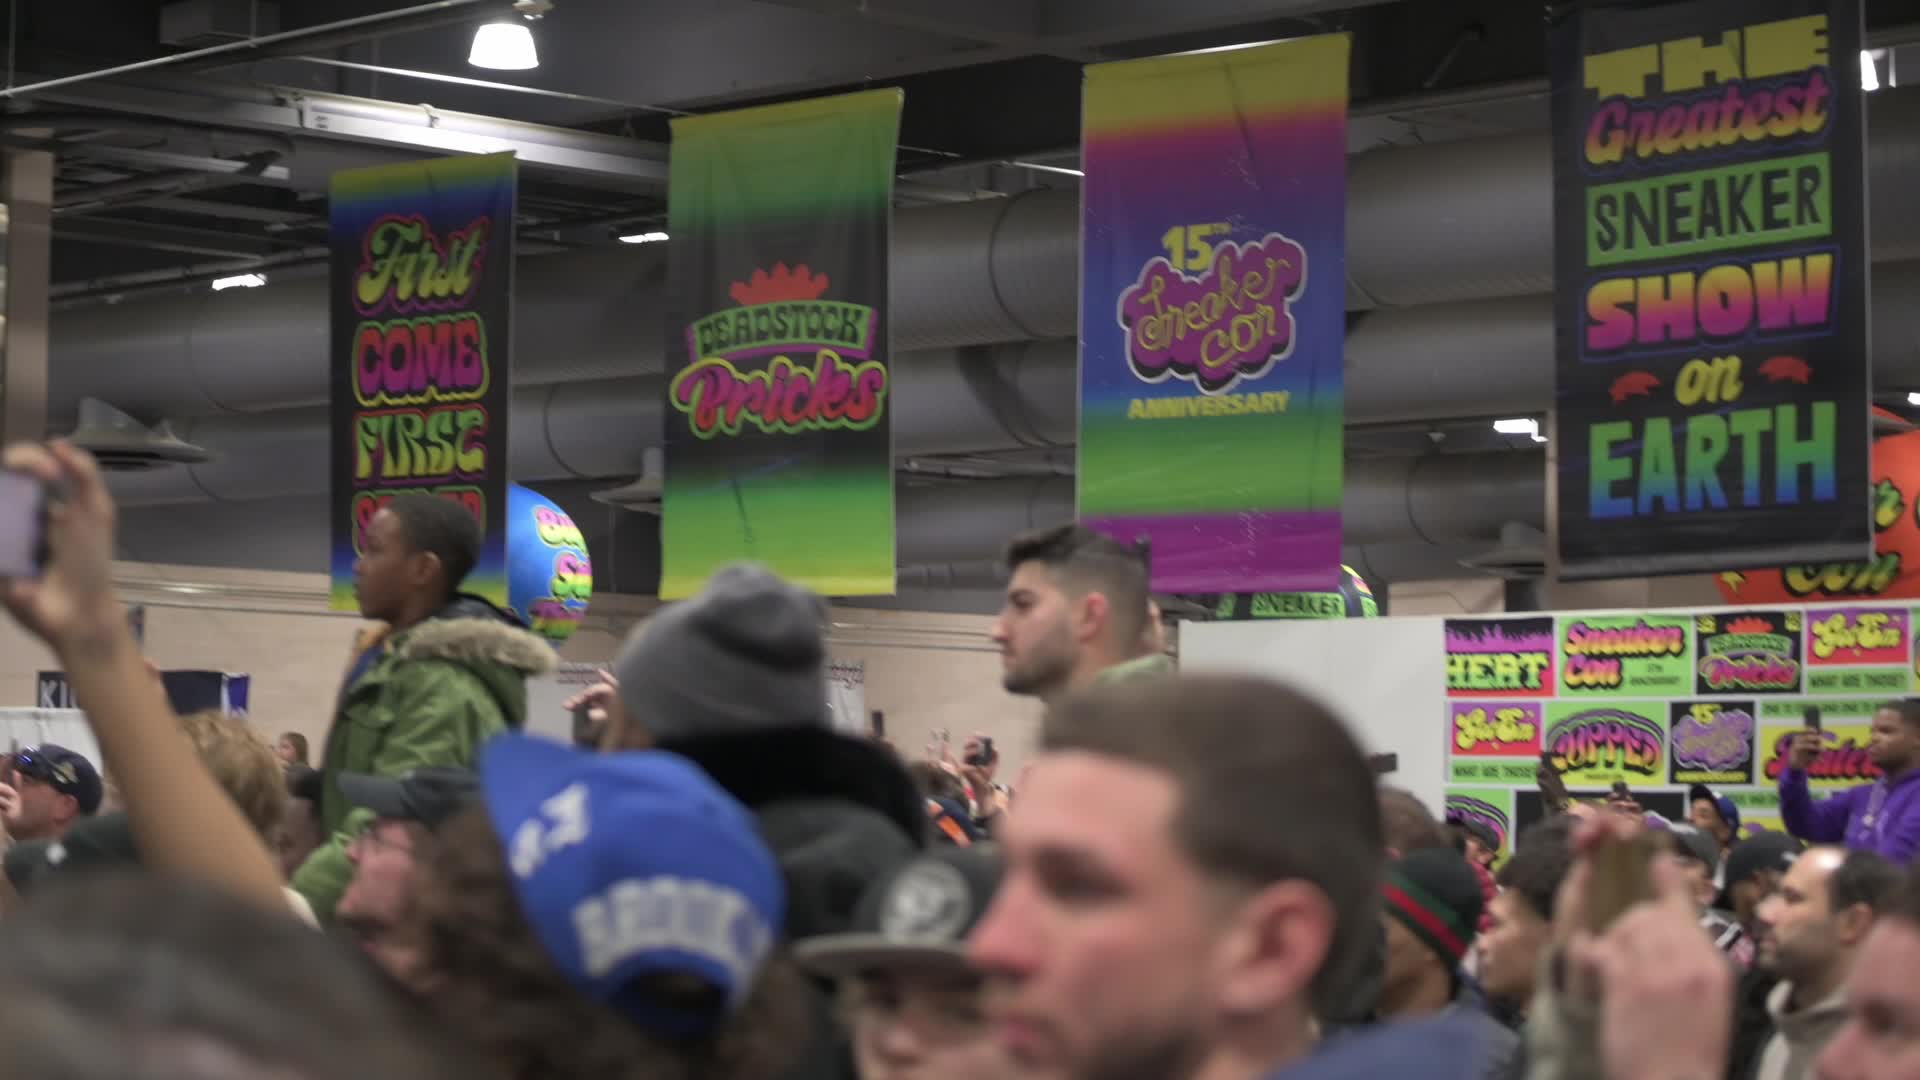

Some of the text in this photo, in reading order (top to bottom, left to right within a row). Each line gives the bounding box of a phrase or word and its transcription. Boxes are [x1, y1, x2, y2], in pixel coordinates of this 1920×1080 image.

[1584, 14, 1829, 101] THE
[1584, 70, 1831, 166] Greatest
[1594, 162, 1823, 253] SNEAKER
[355, 217, 487, 305] First
[1587, 253, 1833, 350] SHOW
[357, 318, 484, 396] COME
[698, 303, 864, 355] DEADSTOCK
[676, 353, 884, 432] Pricks
[1127, 390, 1293, 419] ANNIVERSARY
[1674, 355, 1743, 405] on
[1589, 401, 1837, 519] EARTH
